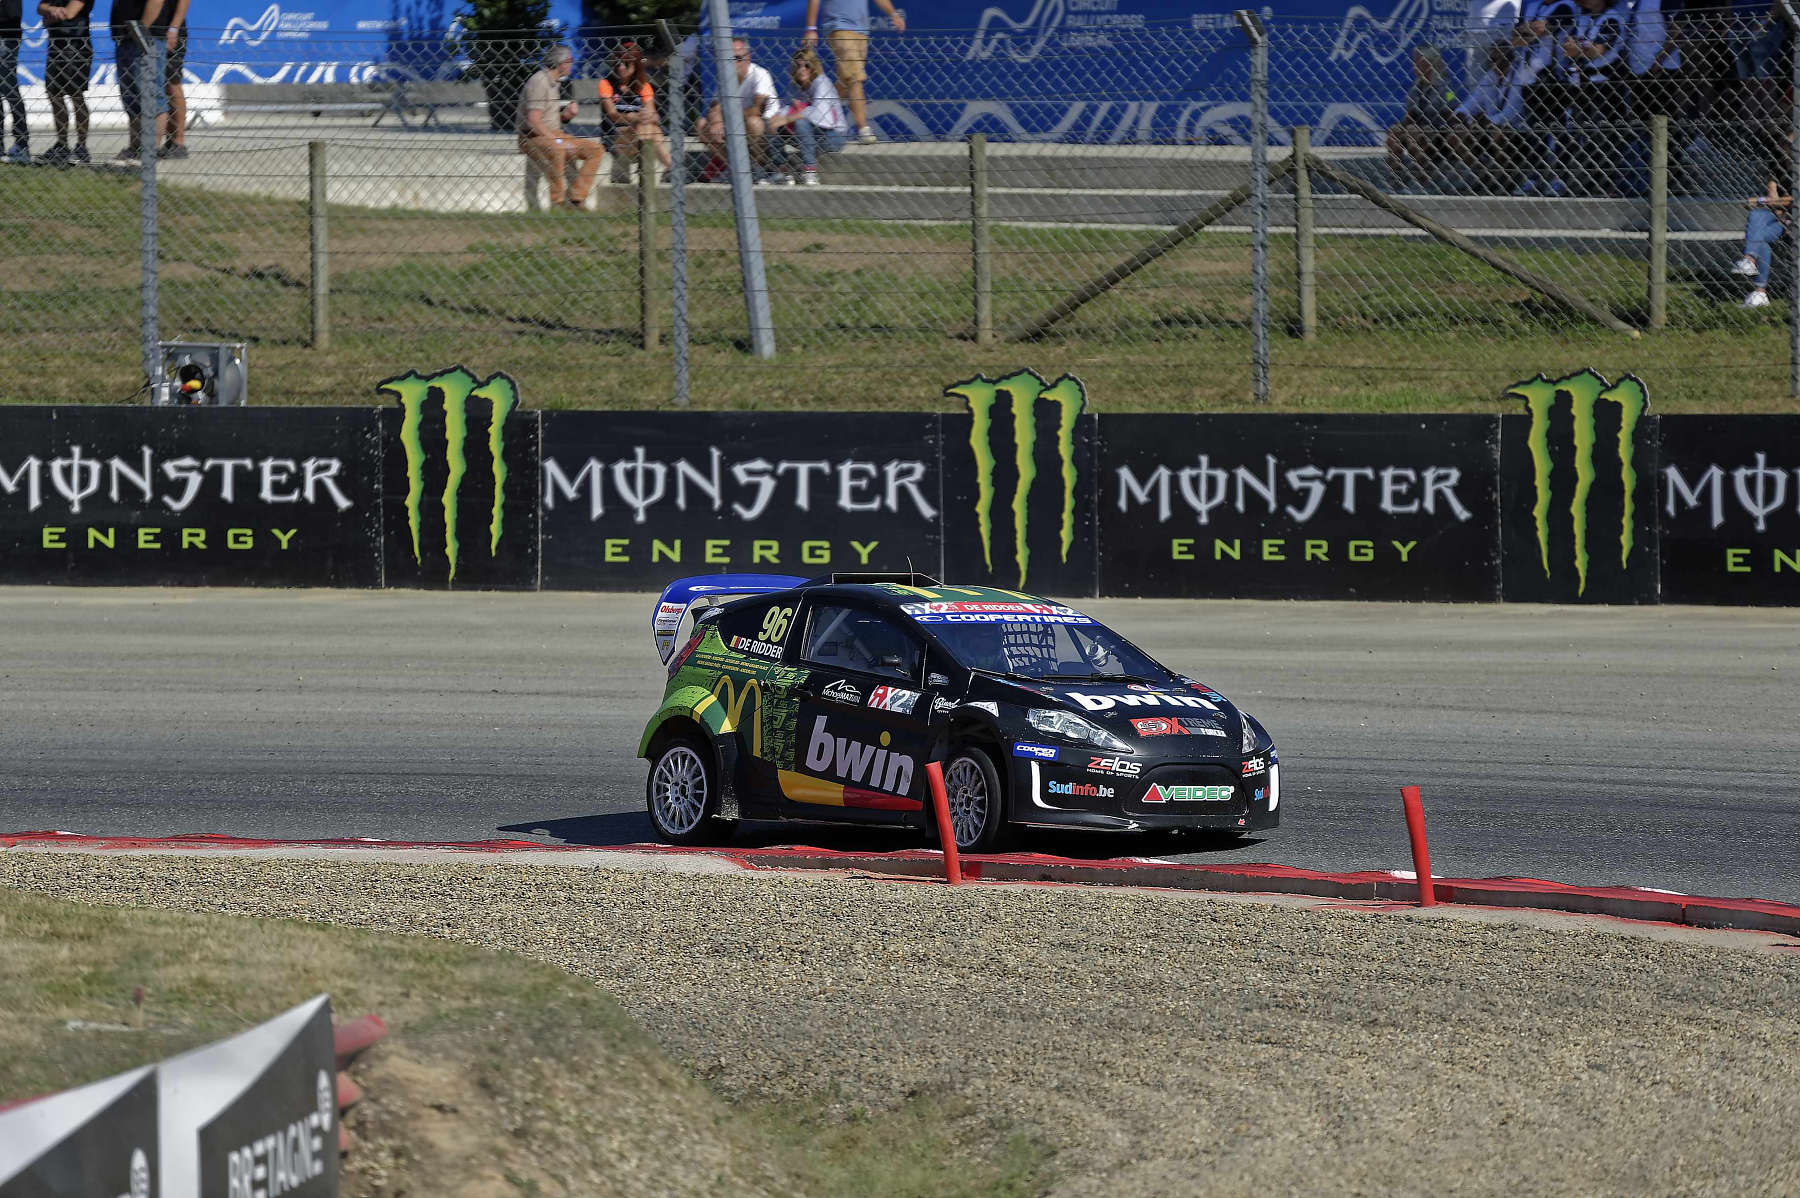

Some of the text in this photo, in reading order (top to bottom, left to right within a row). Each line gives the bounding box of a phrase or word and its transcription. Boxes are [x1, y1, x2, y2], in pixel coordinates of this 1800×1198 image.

[0, 446, 353, 513] MONSTER
[543, 447, 937, 522] MONSTER
[1116, 455, 1471, 524] MONSTER
[1660, 452, 1800, 531] MO
[42, 528, 297, 550] ENERGY
[1172, 539, 1417, 562] ENERGY
[604, 539, 878, 565] ENERGY
[983, 605, 1025, 613] RIDDER
[758, 606, 793, 643] 96
[738, 637, 783, 659] DE RIDDER
[1065, 691, 1220, 711] bwin
[805, 714, 915, 797] bwin
[1016, 745, 1056, 755] COOPER
[1048, 781, 1114, 798] Sudinfo.be
[1159, 785, 1231, 801] VEIDEC
